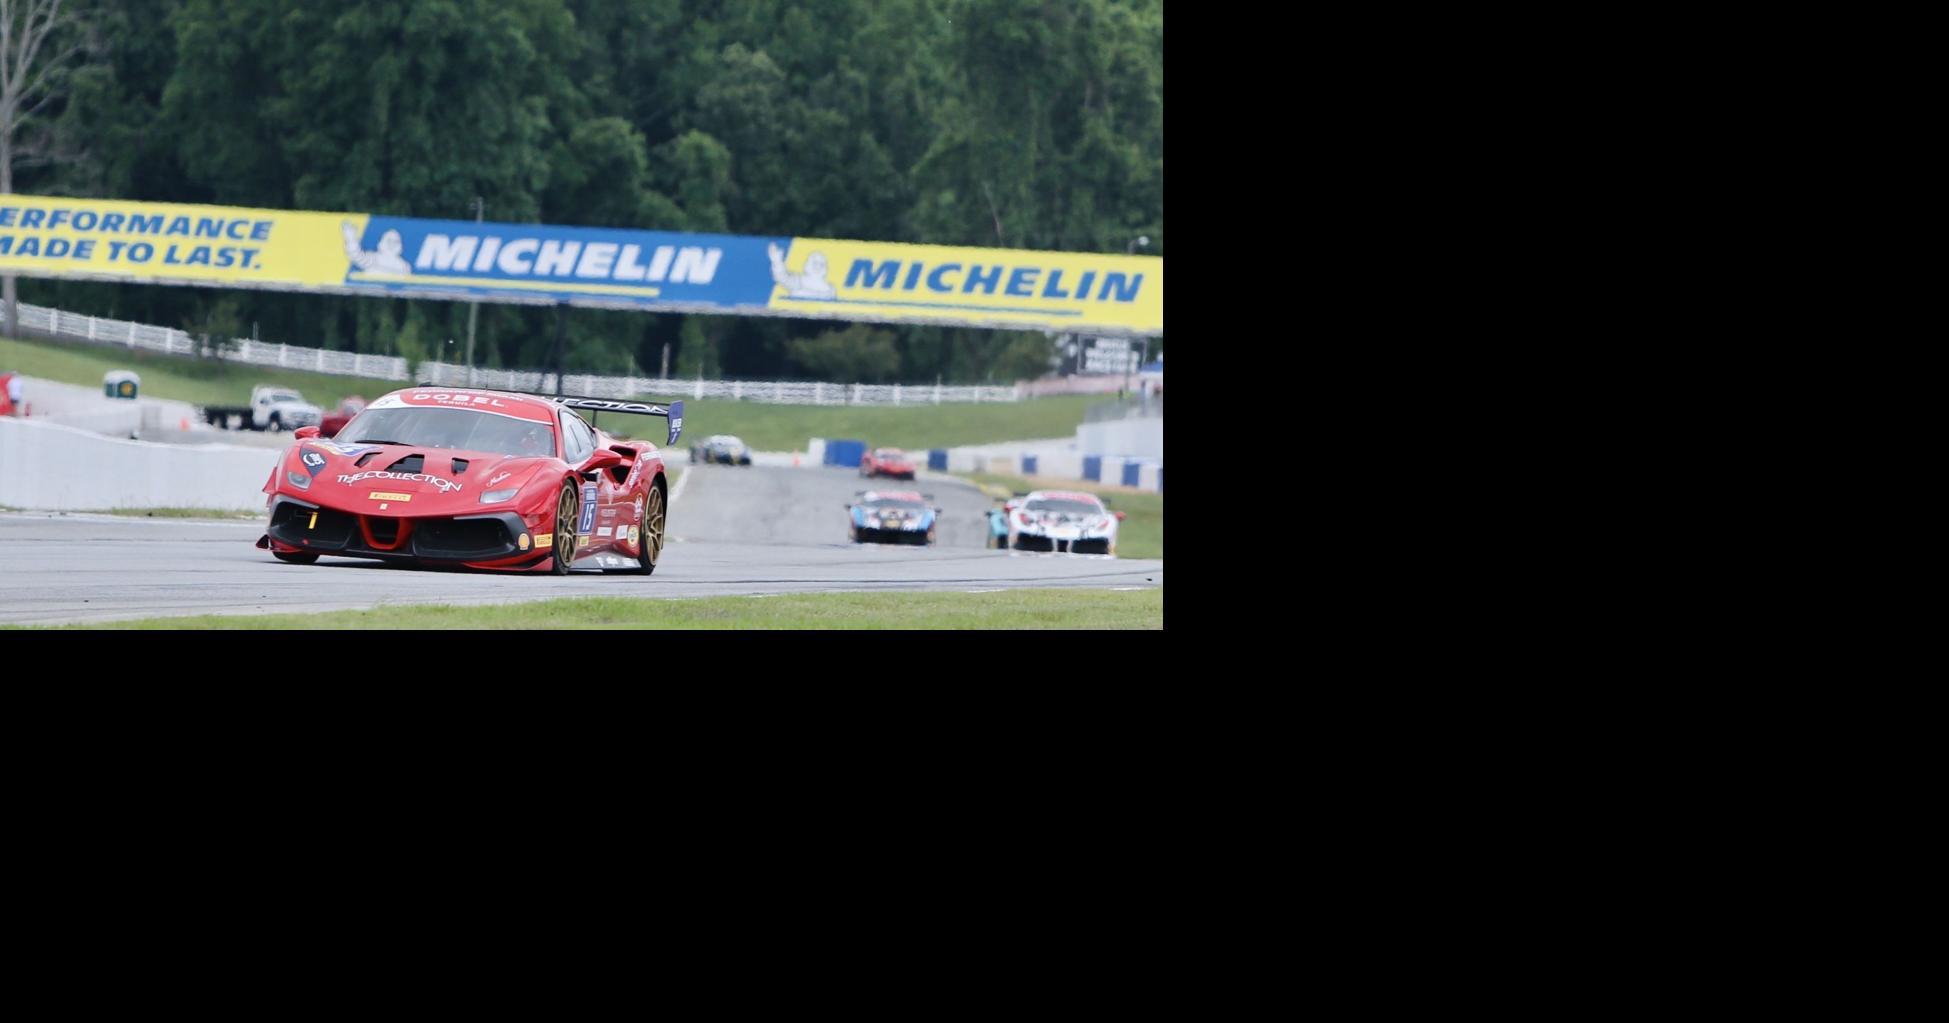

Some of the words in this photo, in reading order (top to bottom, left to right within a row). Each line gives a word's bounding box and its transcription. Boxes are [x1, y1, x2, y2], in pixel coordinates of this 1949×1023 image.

[108, 241, 154, 263] TO
[163, 244, 261, 269] LAST.
[415, 233, 723, 285] MICHELIN
[844, 258, 1144, 302] MICHELIN
[413, 393, 505, 407] DOBEL
[582, 503, 595, 531] 15
